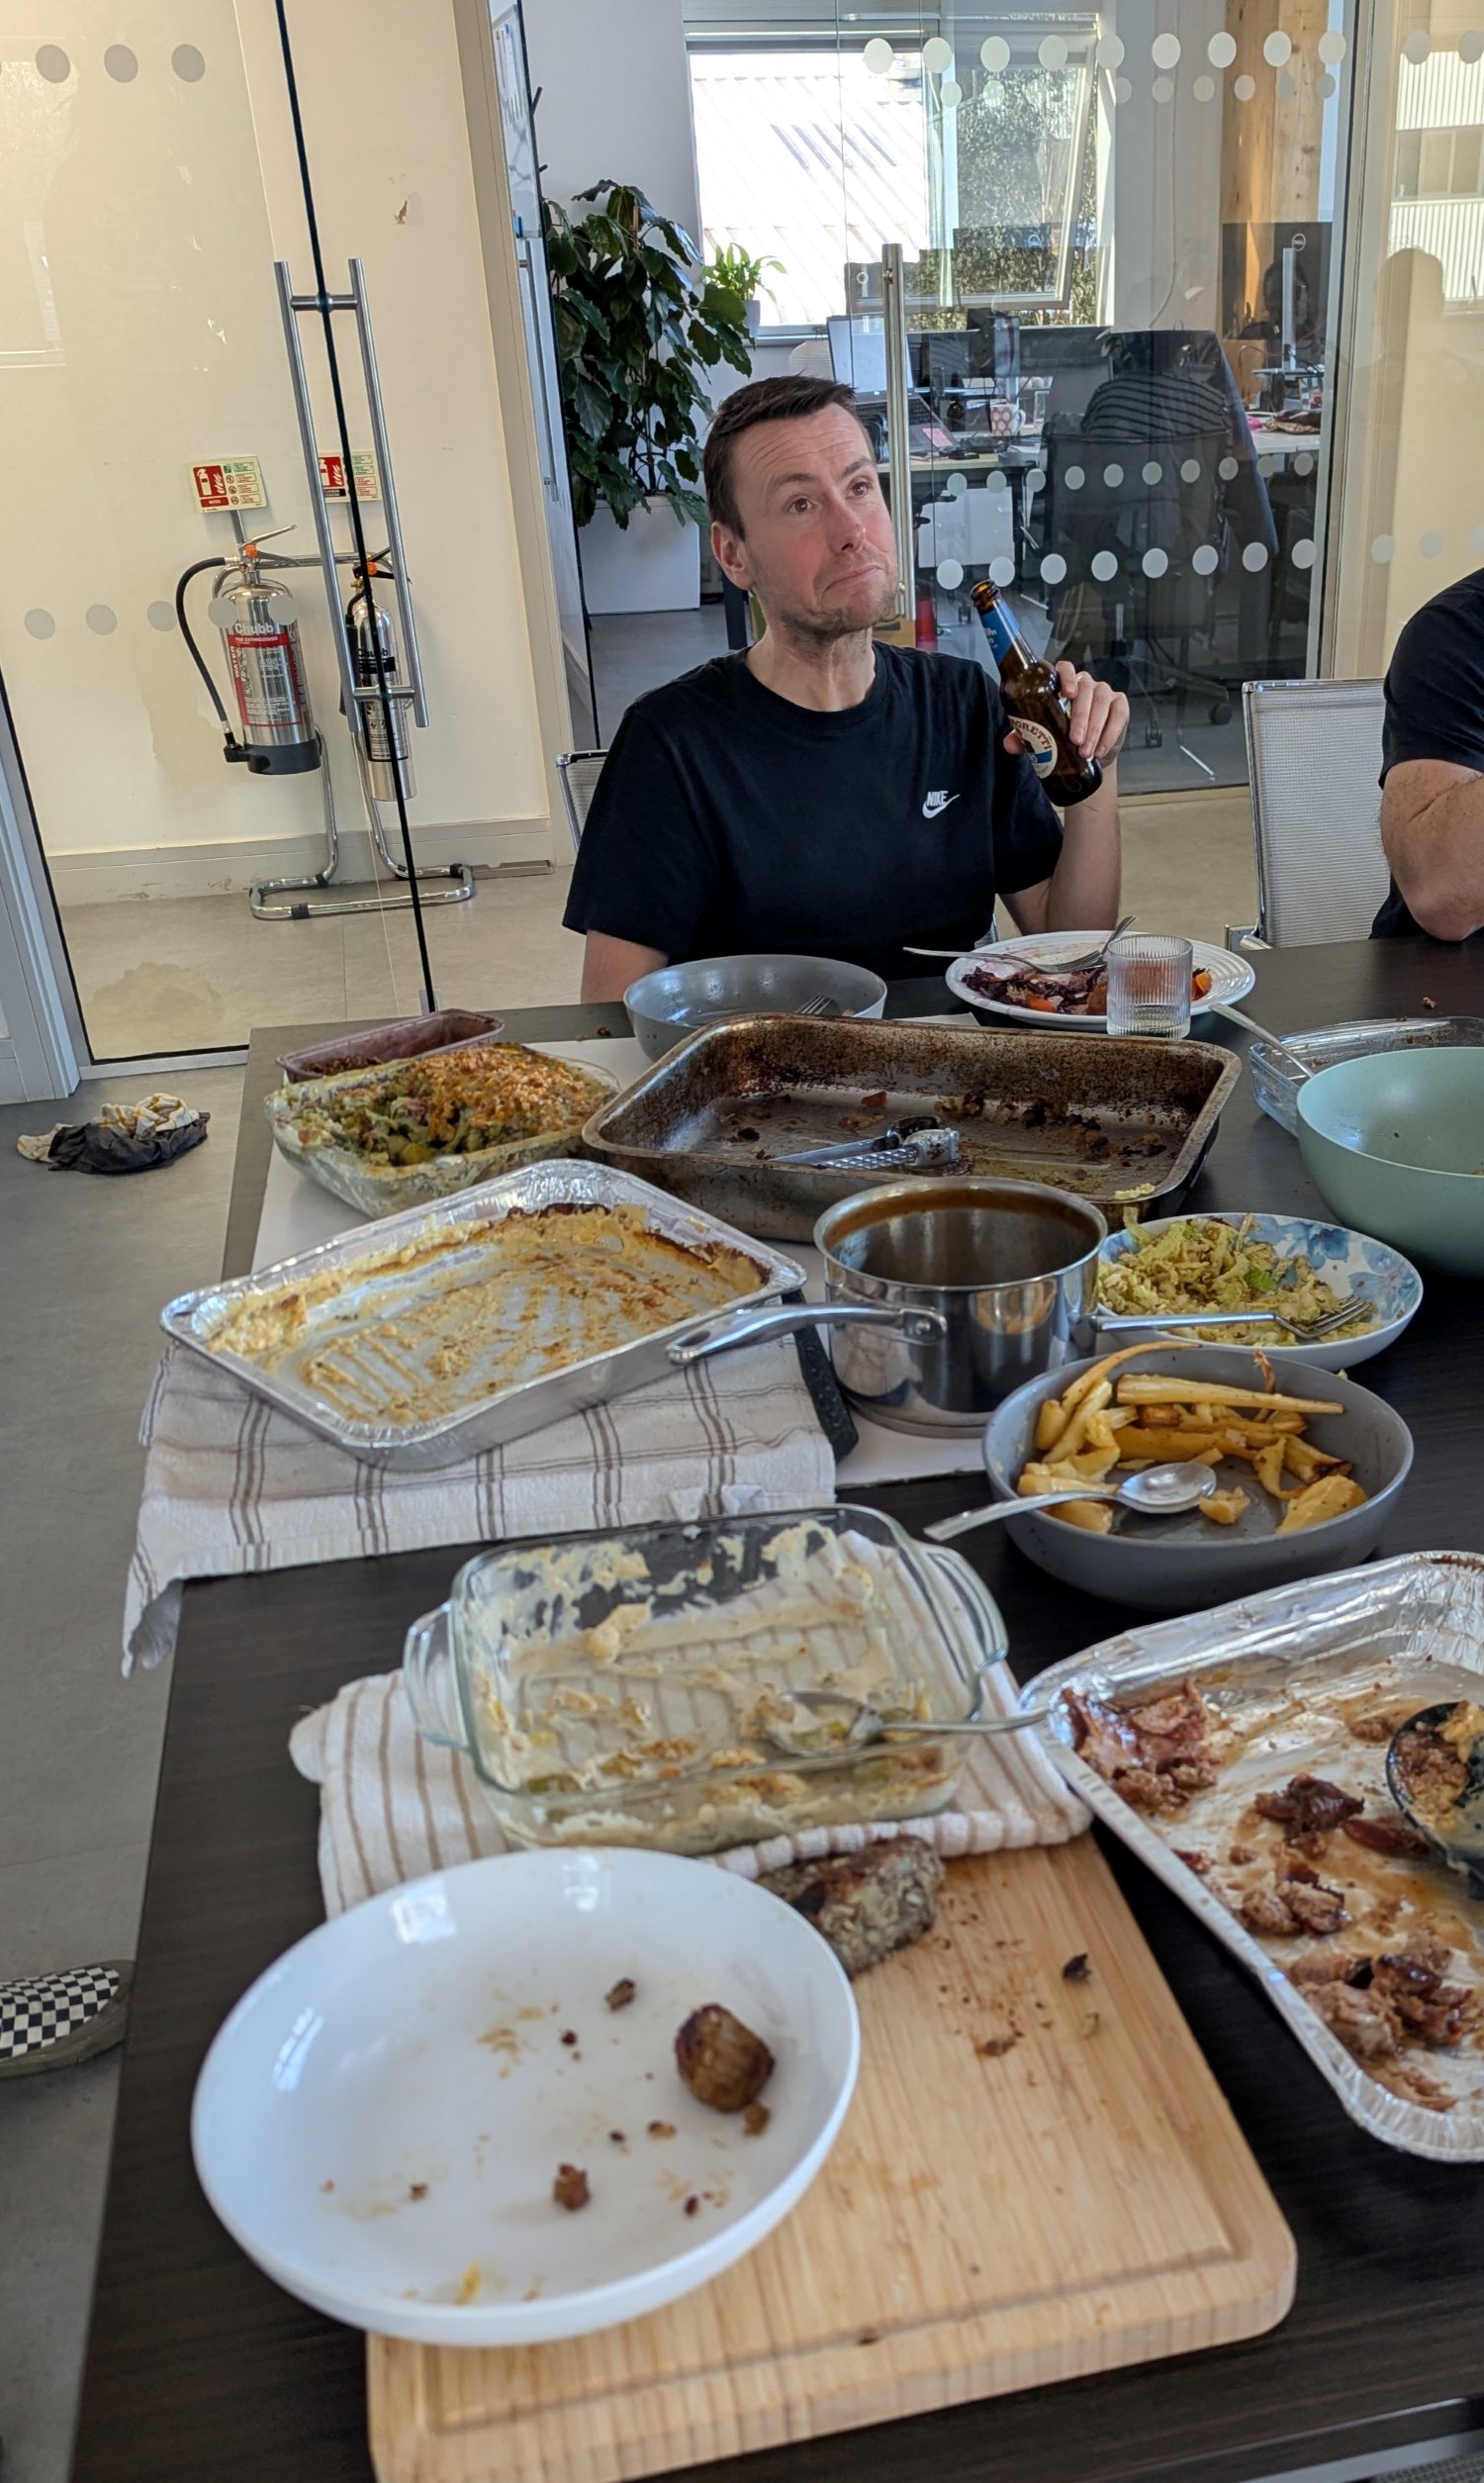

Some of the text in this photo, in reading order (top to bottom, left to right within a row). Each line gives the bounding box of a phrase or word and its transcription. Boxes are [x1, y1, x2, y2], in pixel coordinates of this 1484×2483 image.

[234, 622, 274, 634] Chubb
[357, 648, 389, 658] Chub
[230, 645, 240, 678] WATER
[927, 790, 949, 807] NIKE
